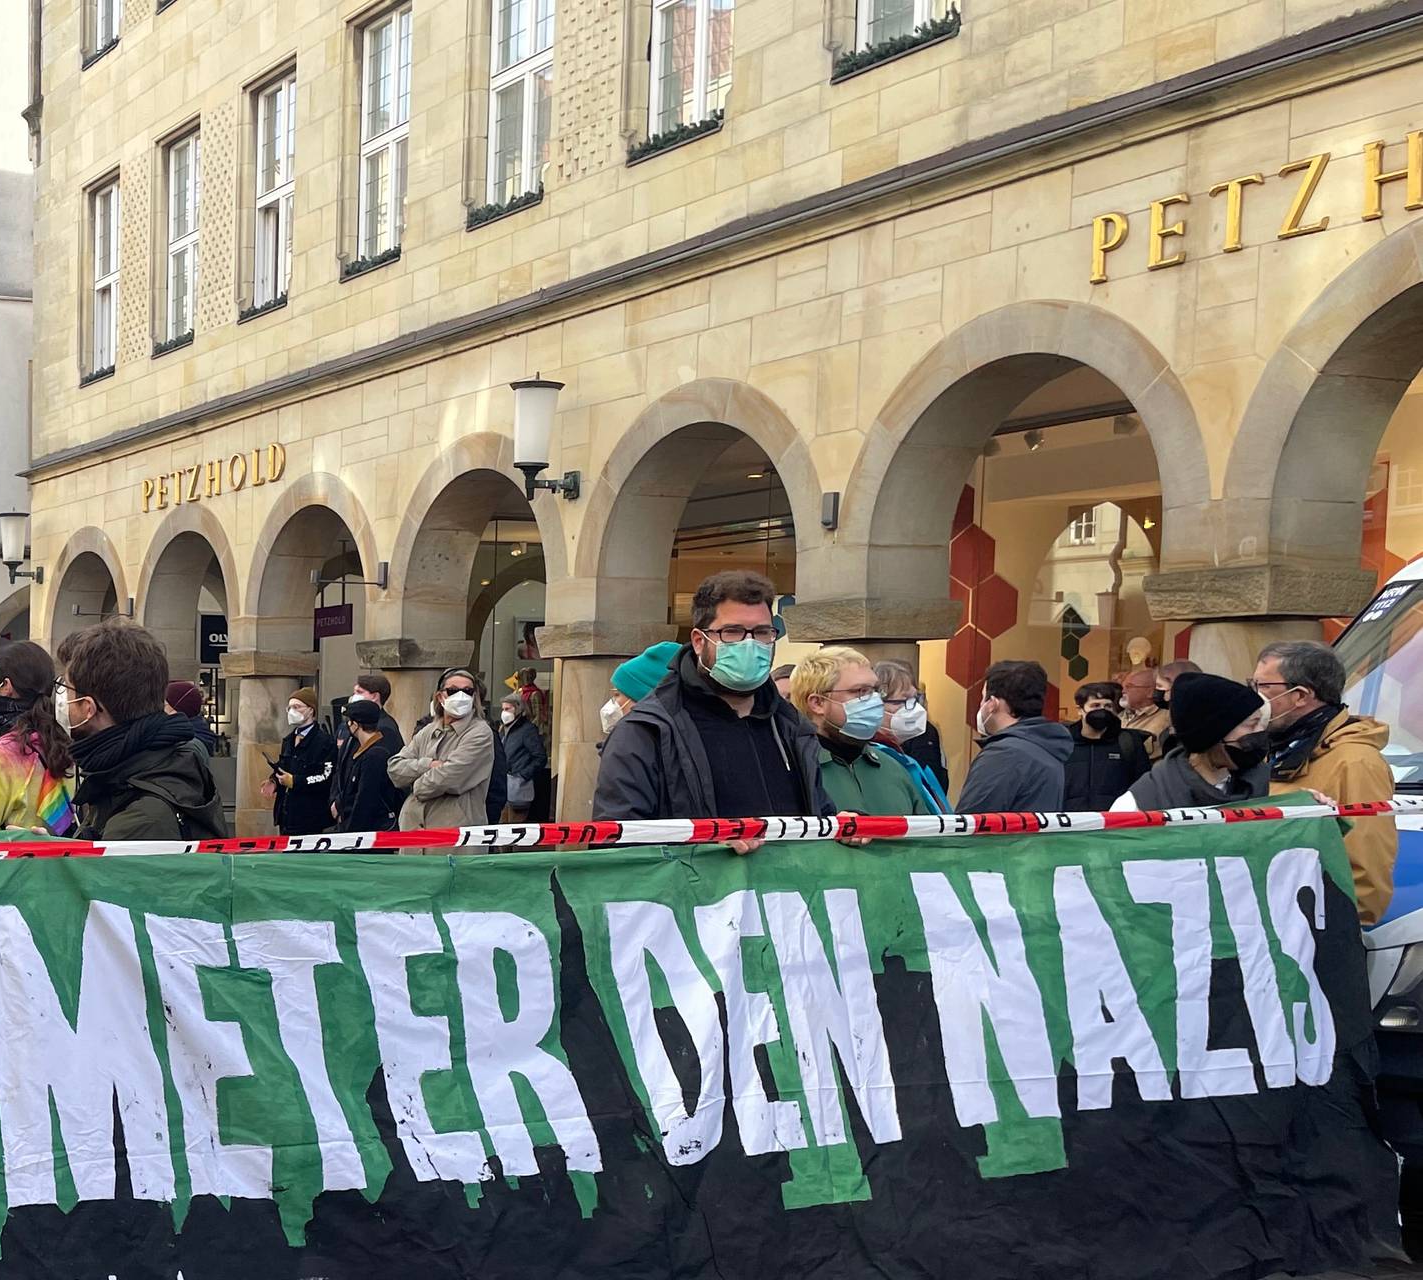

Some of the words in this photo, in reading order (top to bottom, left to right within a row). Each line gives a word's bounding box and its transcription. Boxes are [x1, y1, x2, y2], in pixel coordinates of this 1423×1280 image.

[142, 442, 286, 512] PETZHOLD
[316, 615, 347, 628] PETZHOLD
[604, 888, 902, 1166] DEN
[909, 848, 1337, 1127] NAZIS
